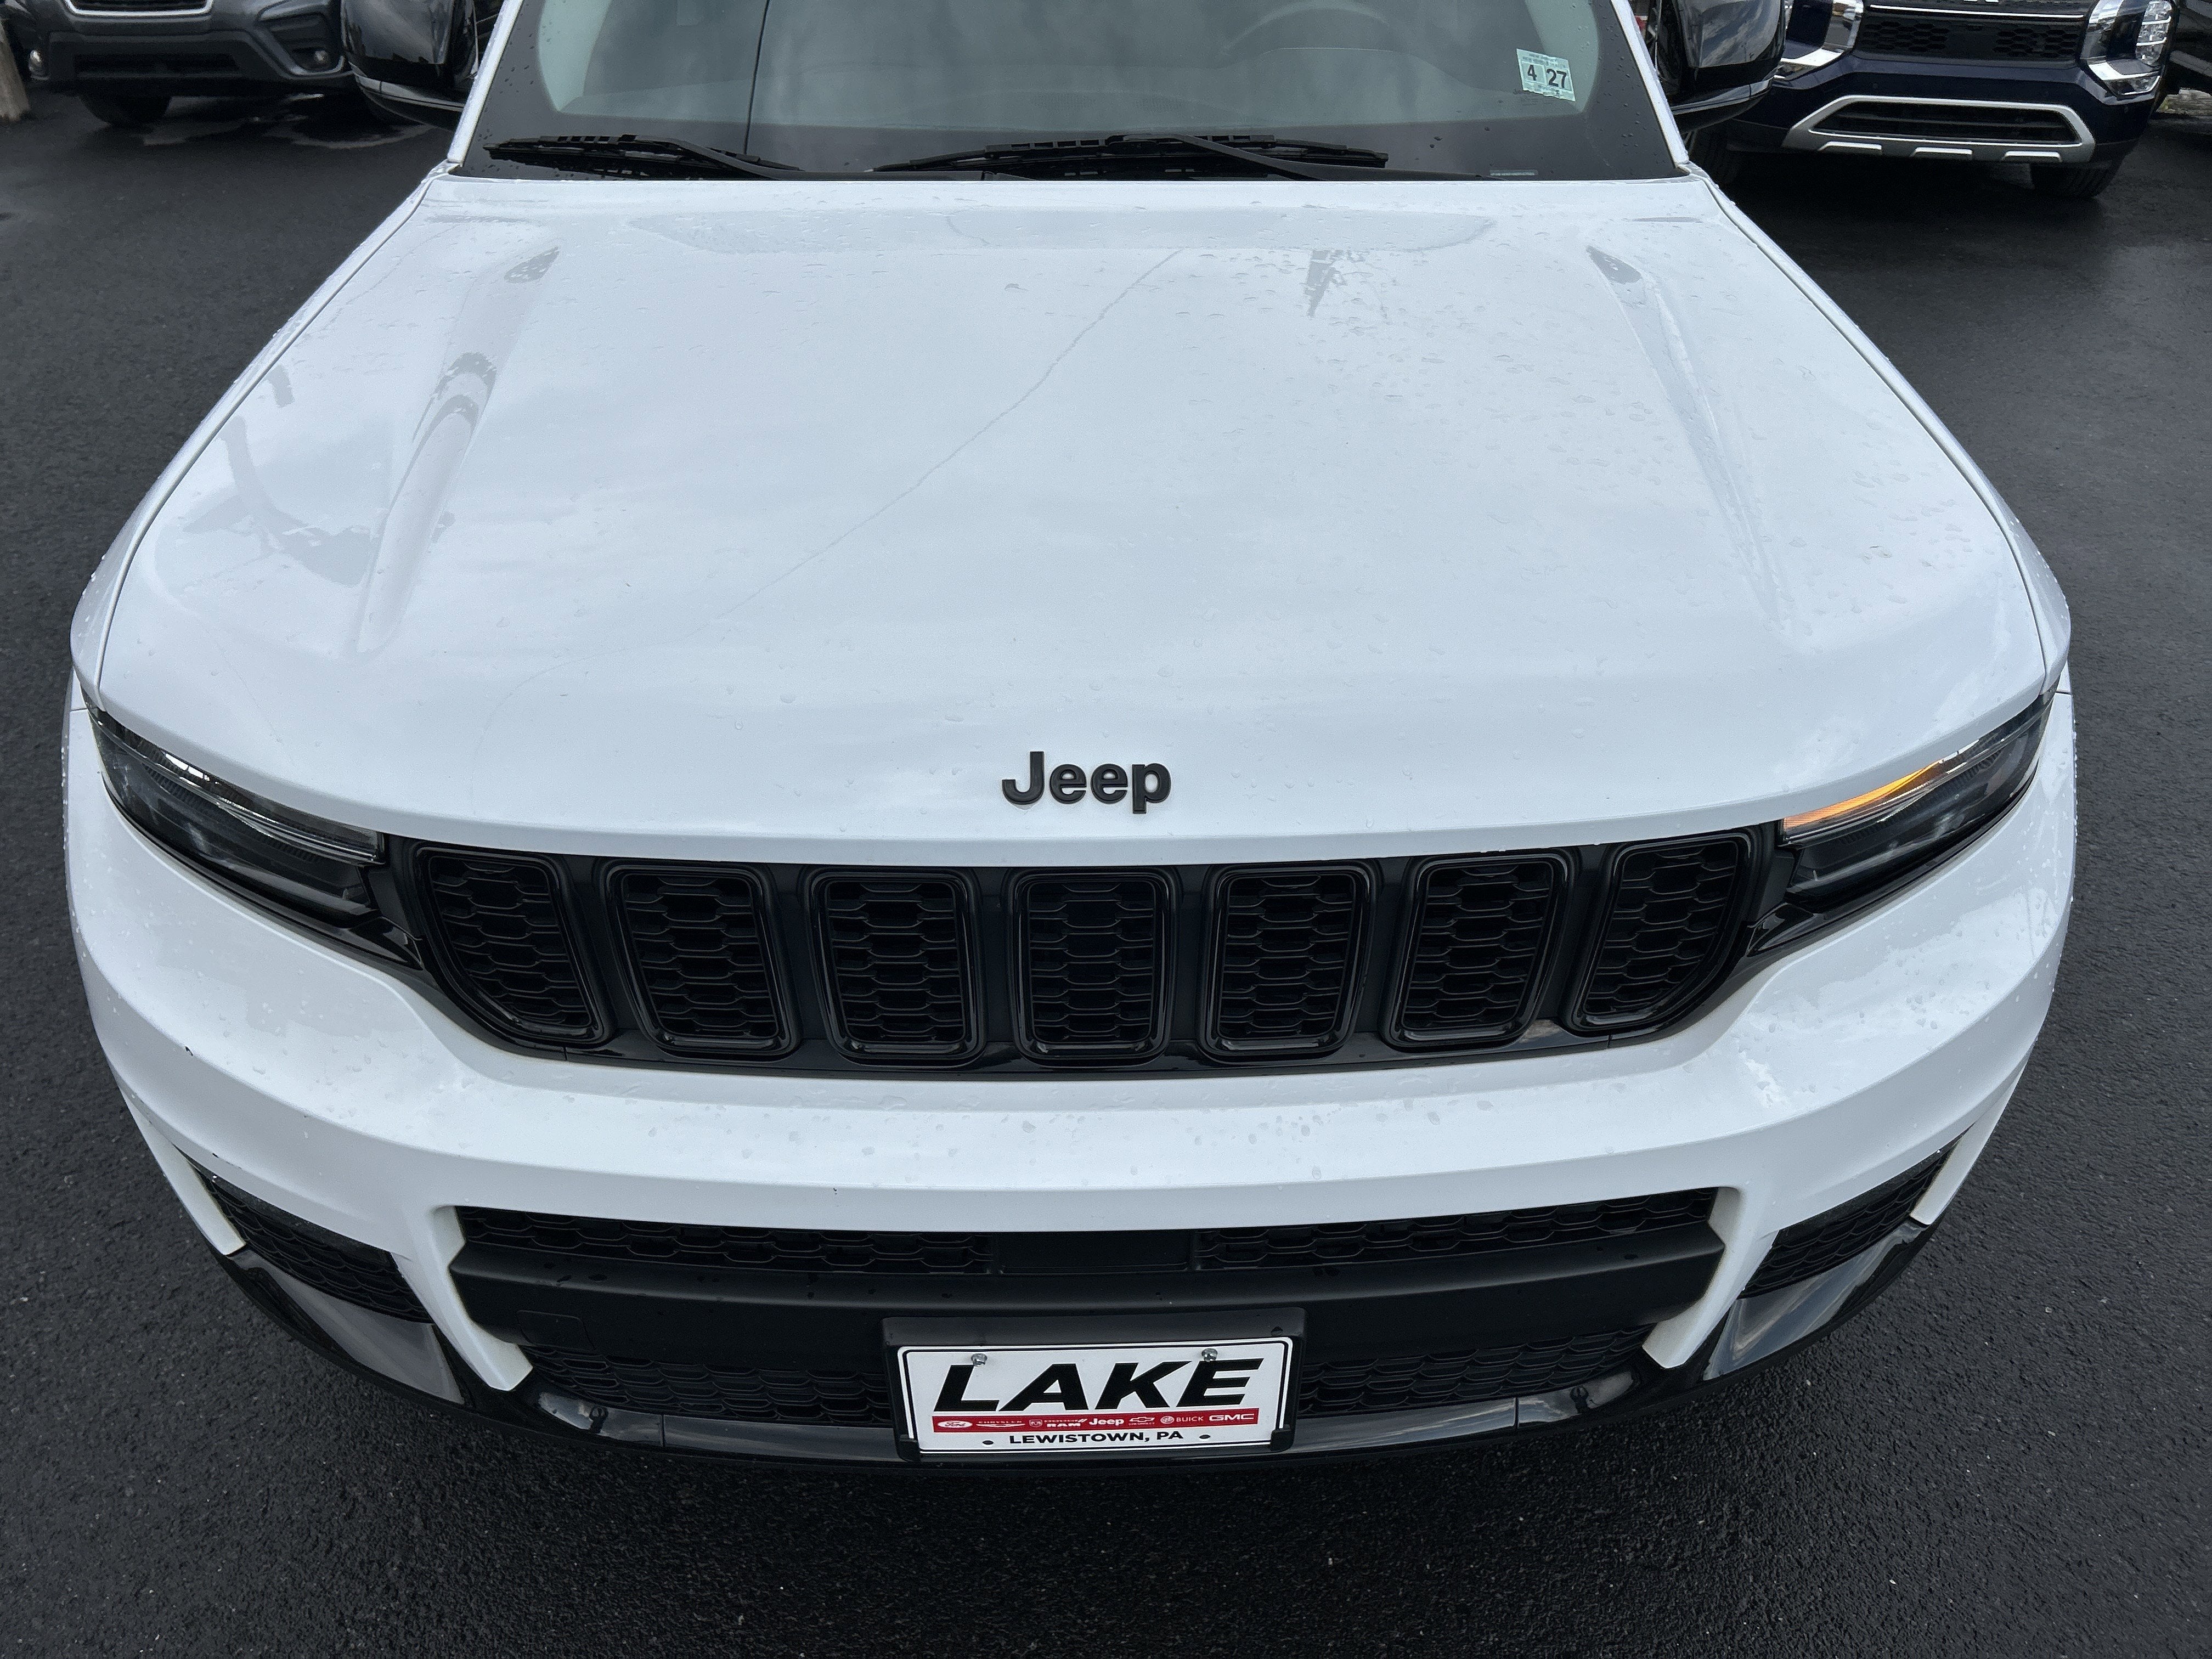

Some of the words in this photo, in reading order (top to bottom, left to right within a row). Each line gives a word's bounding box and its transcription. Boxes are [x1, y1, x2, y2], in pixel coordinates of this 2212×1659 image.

[1527, 65, 1537, 81] 4
[1546, 69, 1567, 88] 27
[1002, 751, 1171, 814] Jeep
[933, 1358, 1265, 1412] LAKE
[1088, 1418, 1125, 1426] Jeep
[1209, 1413, 1255, 1421] GMC
[1009, 1432, 1149, 1444] LEWISTOWN,
[1156, 1431, 1183, 1441] PA
